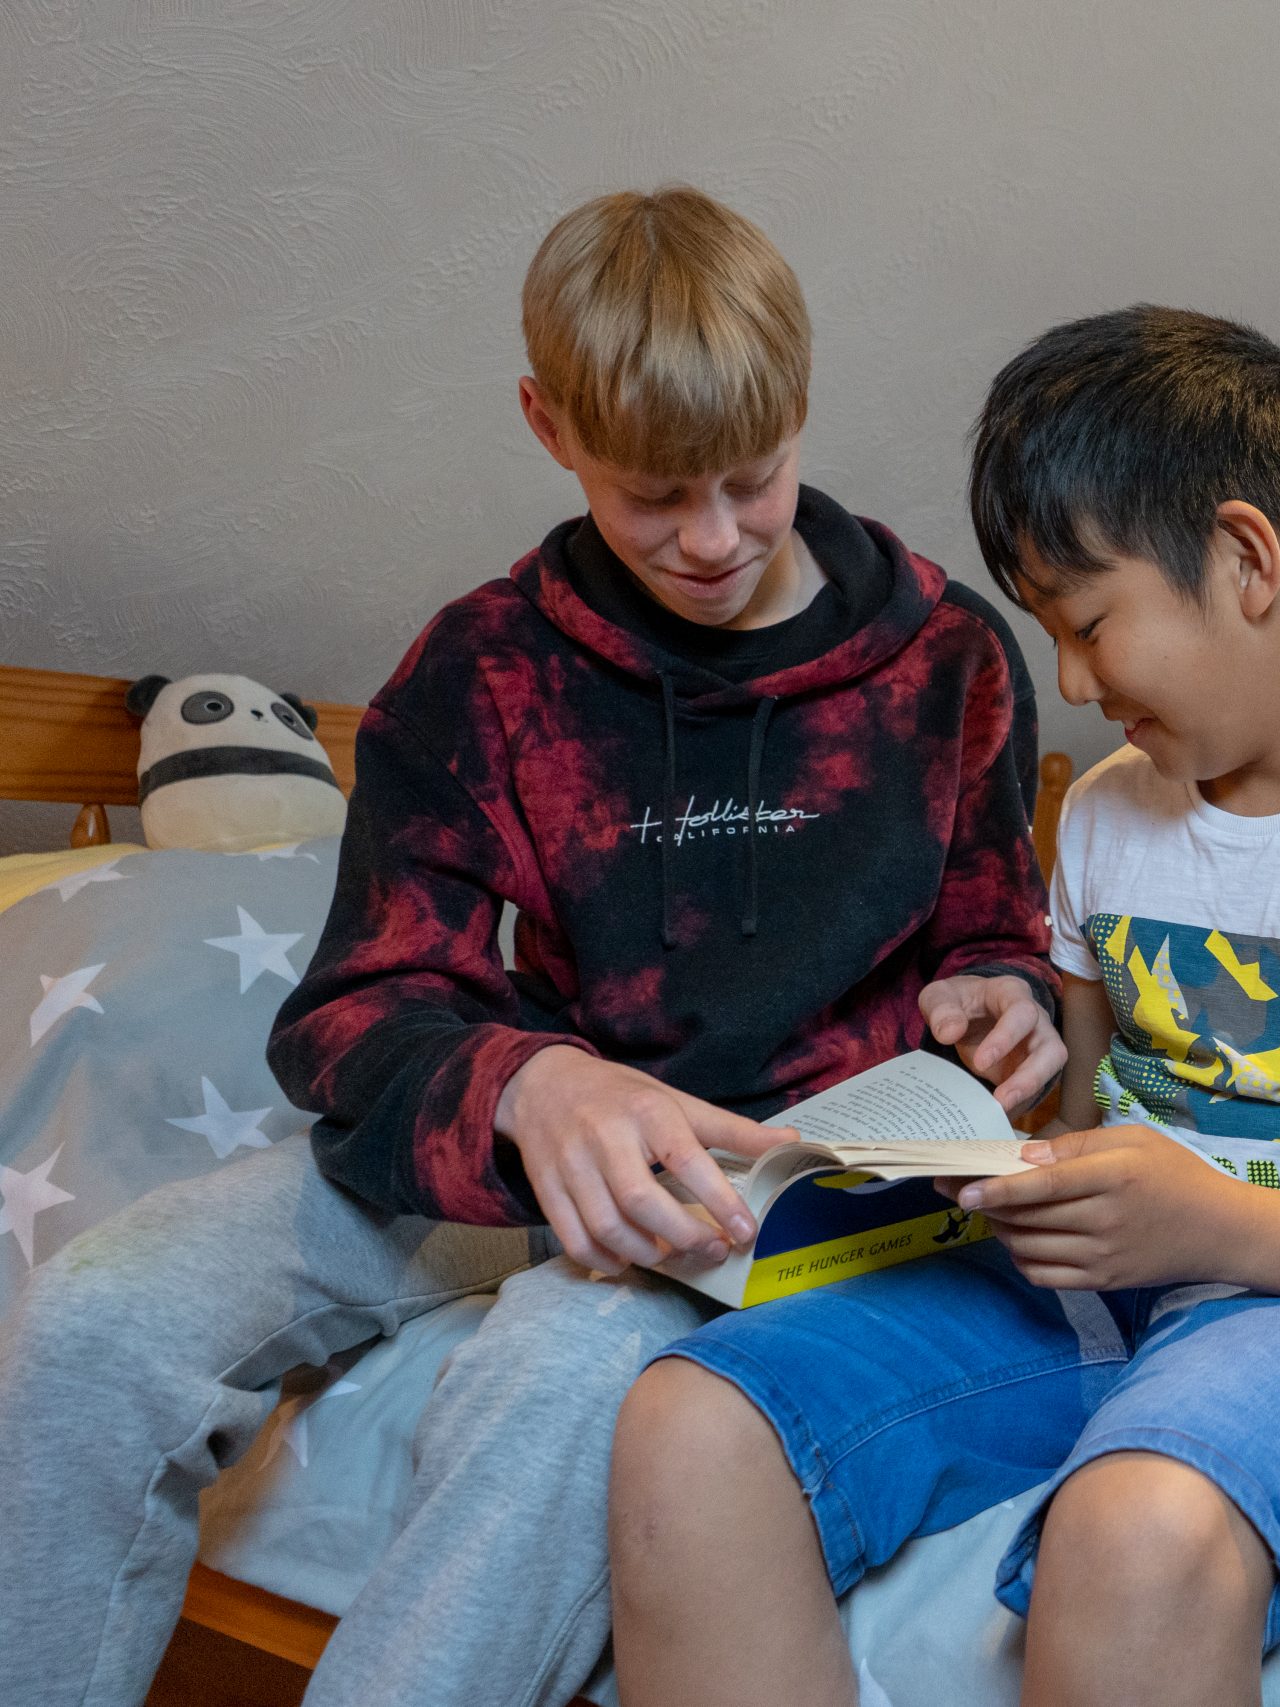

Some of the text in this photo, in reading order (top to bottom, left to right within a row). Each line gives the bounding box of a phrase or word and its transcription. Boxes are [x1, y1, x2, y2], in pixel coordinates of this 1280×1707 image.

[777, 1233, 913, 1283] THE HUNGER GAMES
